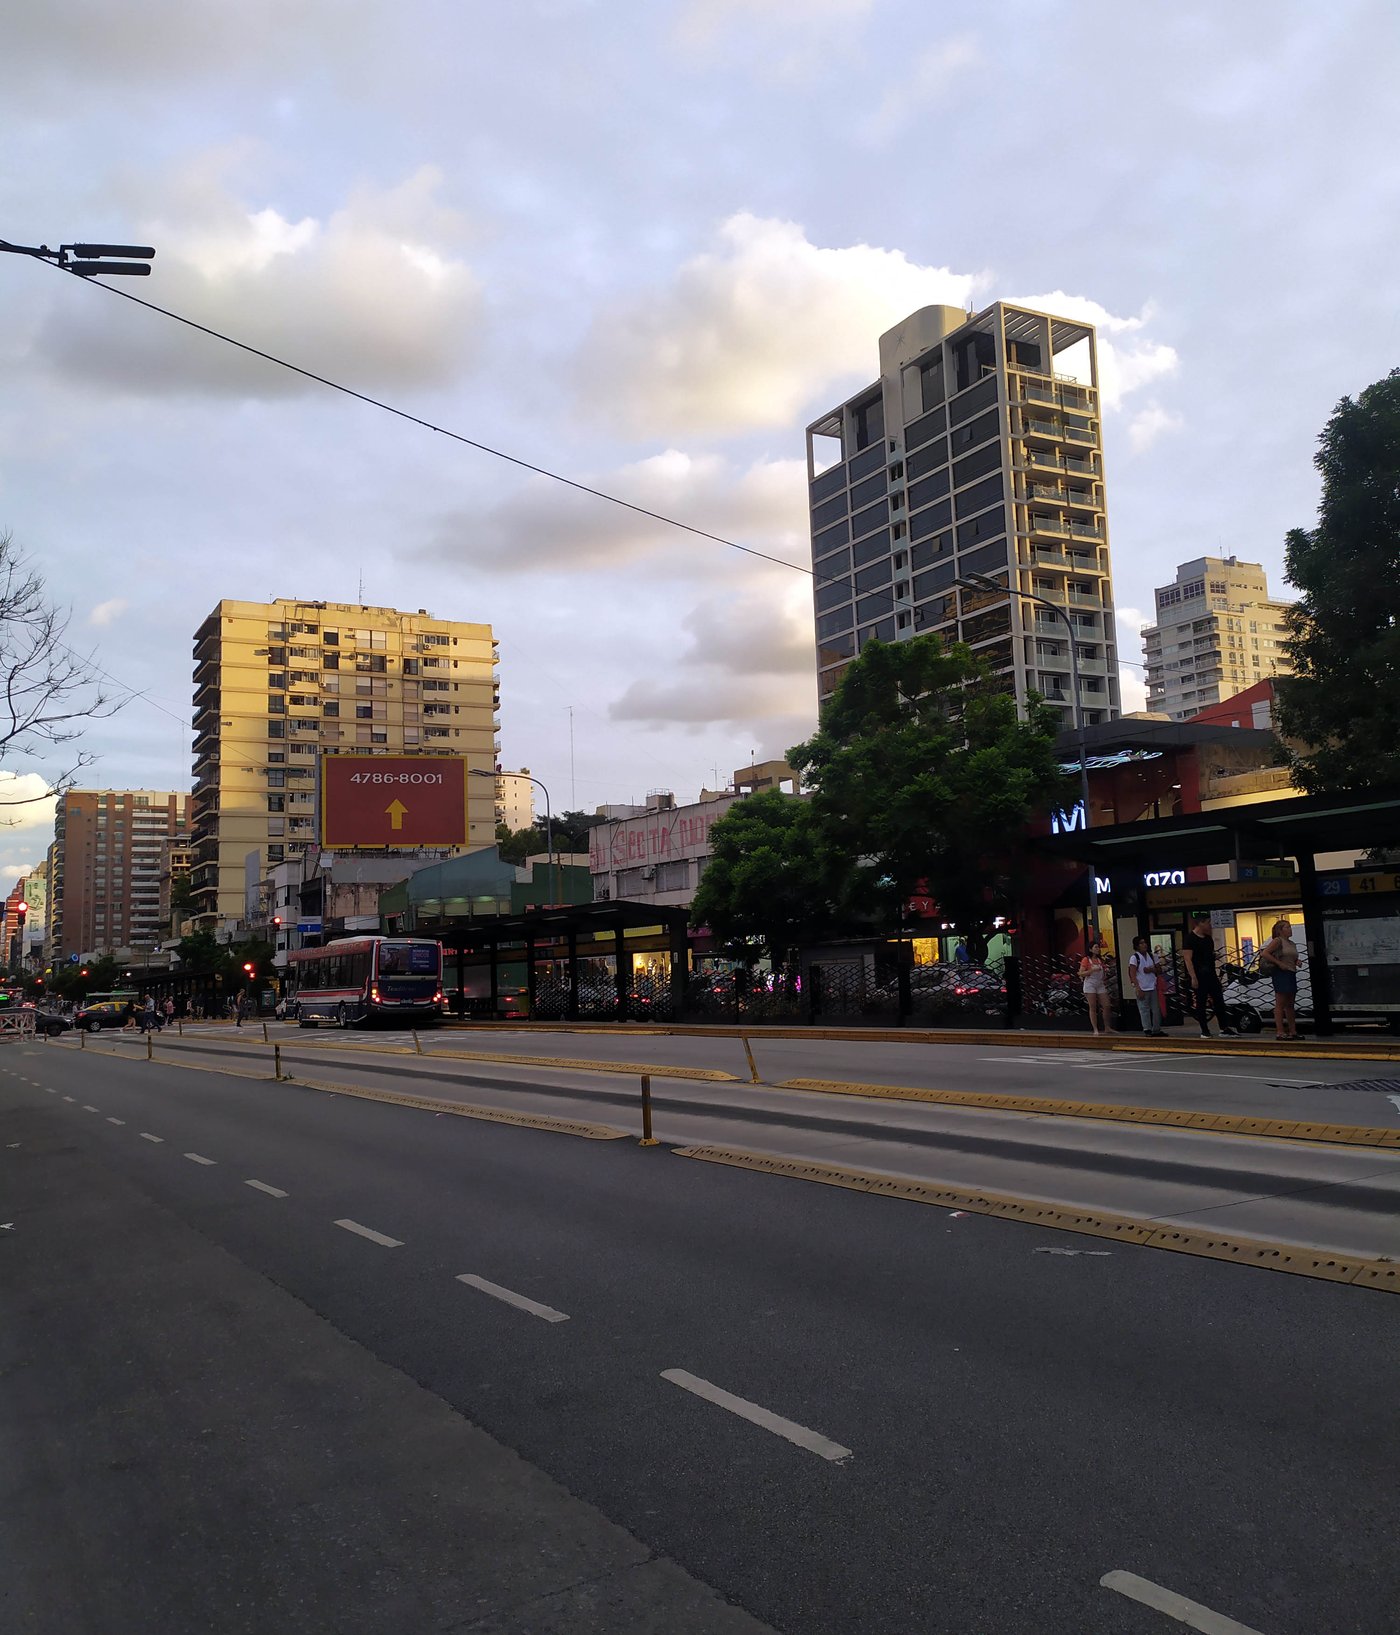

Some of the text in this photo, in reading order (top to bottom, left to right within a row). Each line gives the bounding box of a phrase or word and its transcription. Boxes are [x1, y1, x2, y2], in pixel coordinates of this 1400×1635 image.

[350, 773, 443, 784] 4786-8001
[1095, 870, 1185, 894] Maza
[1323, 880, 1341, 895] 29
[1359, 877, 1376, 890] 41
